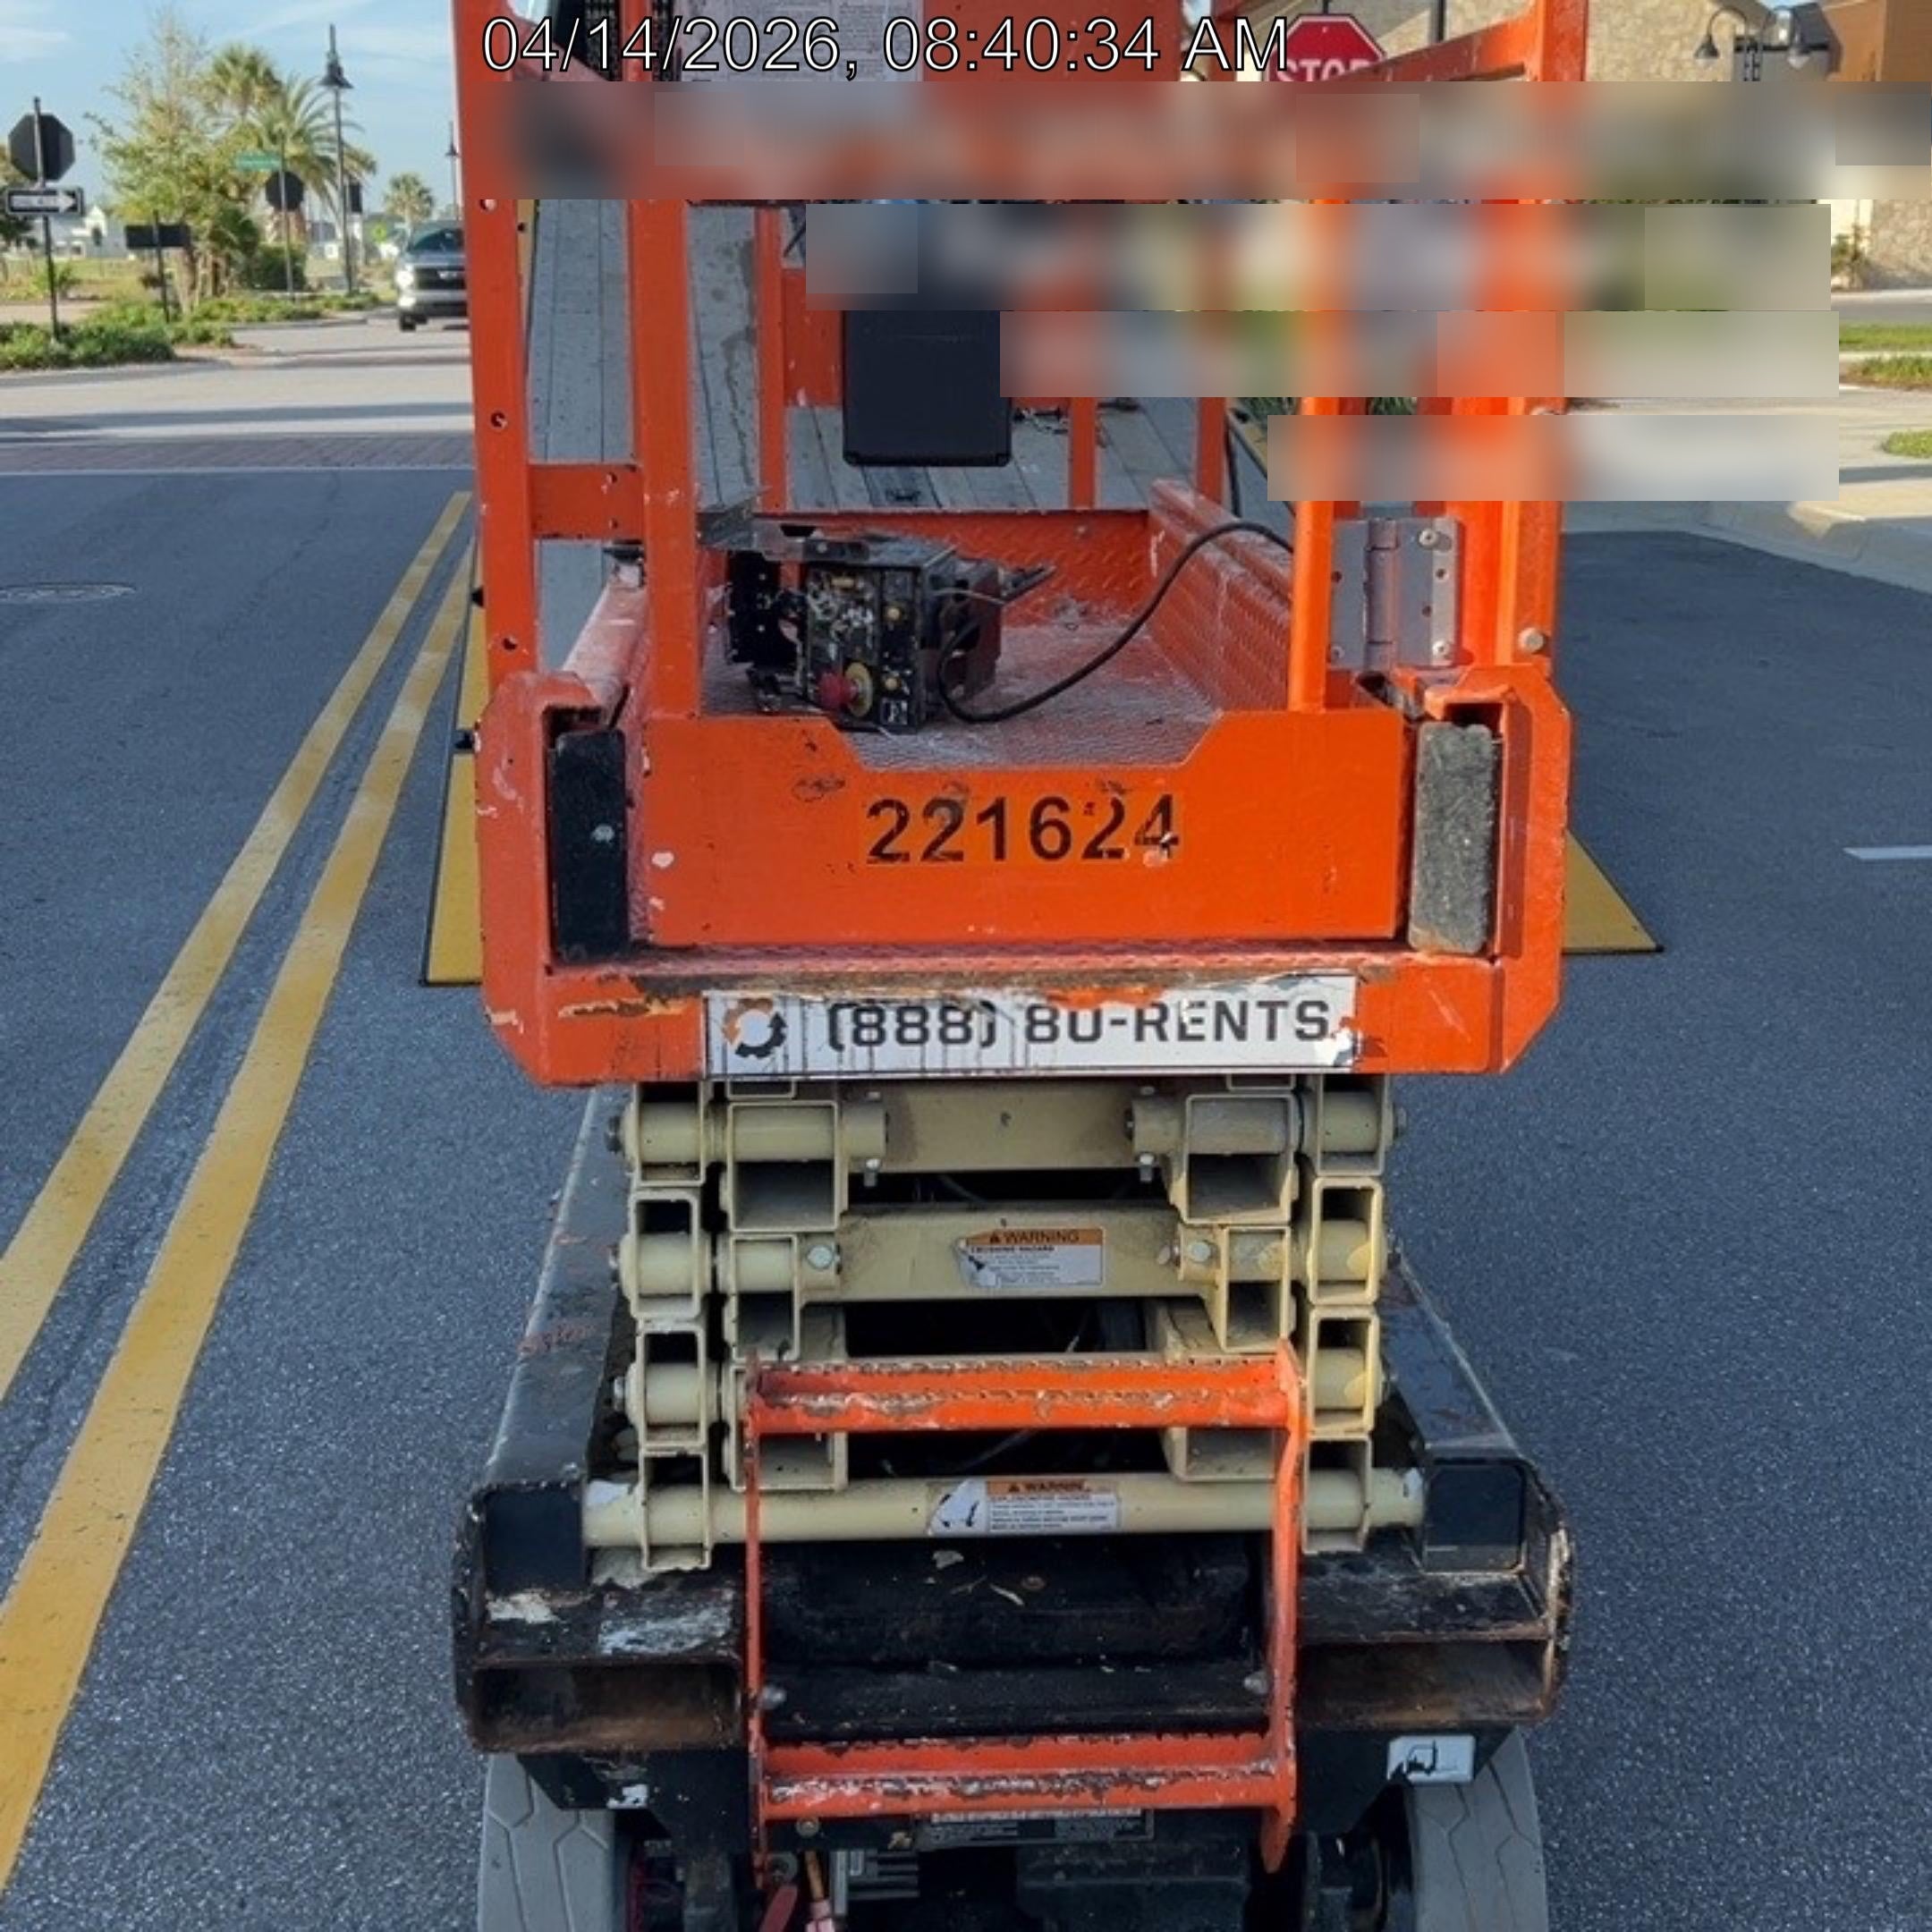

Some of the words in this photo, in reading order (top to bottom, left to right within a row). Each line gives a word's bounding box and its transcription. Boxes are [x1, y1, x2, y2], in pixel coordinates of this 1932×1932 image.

[1276, 57, 1369, 82] ST
[866, 793, 1179, 863] 221624
[827, 1002, 996, 1050] (888)
[1004, 1231, 1080, 1244] WARNING
[1024, 1479, 1090, 1493] WARNIN
